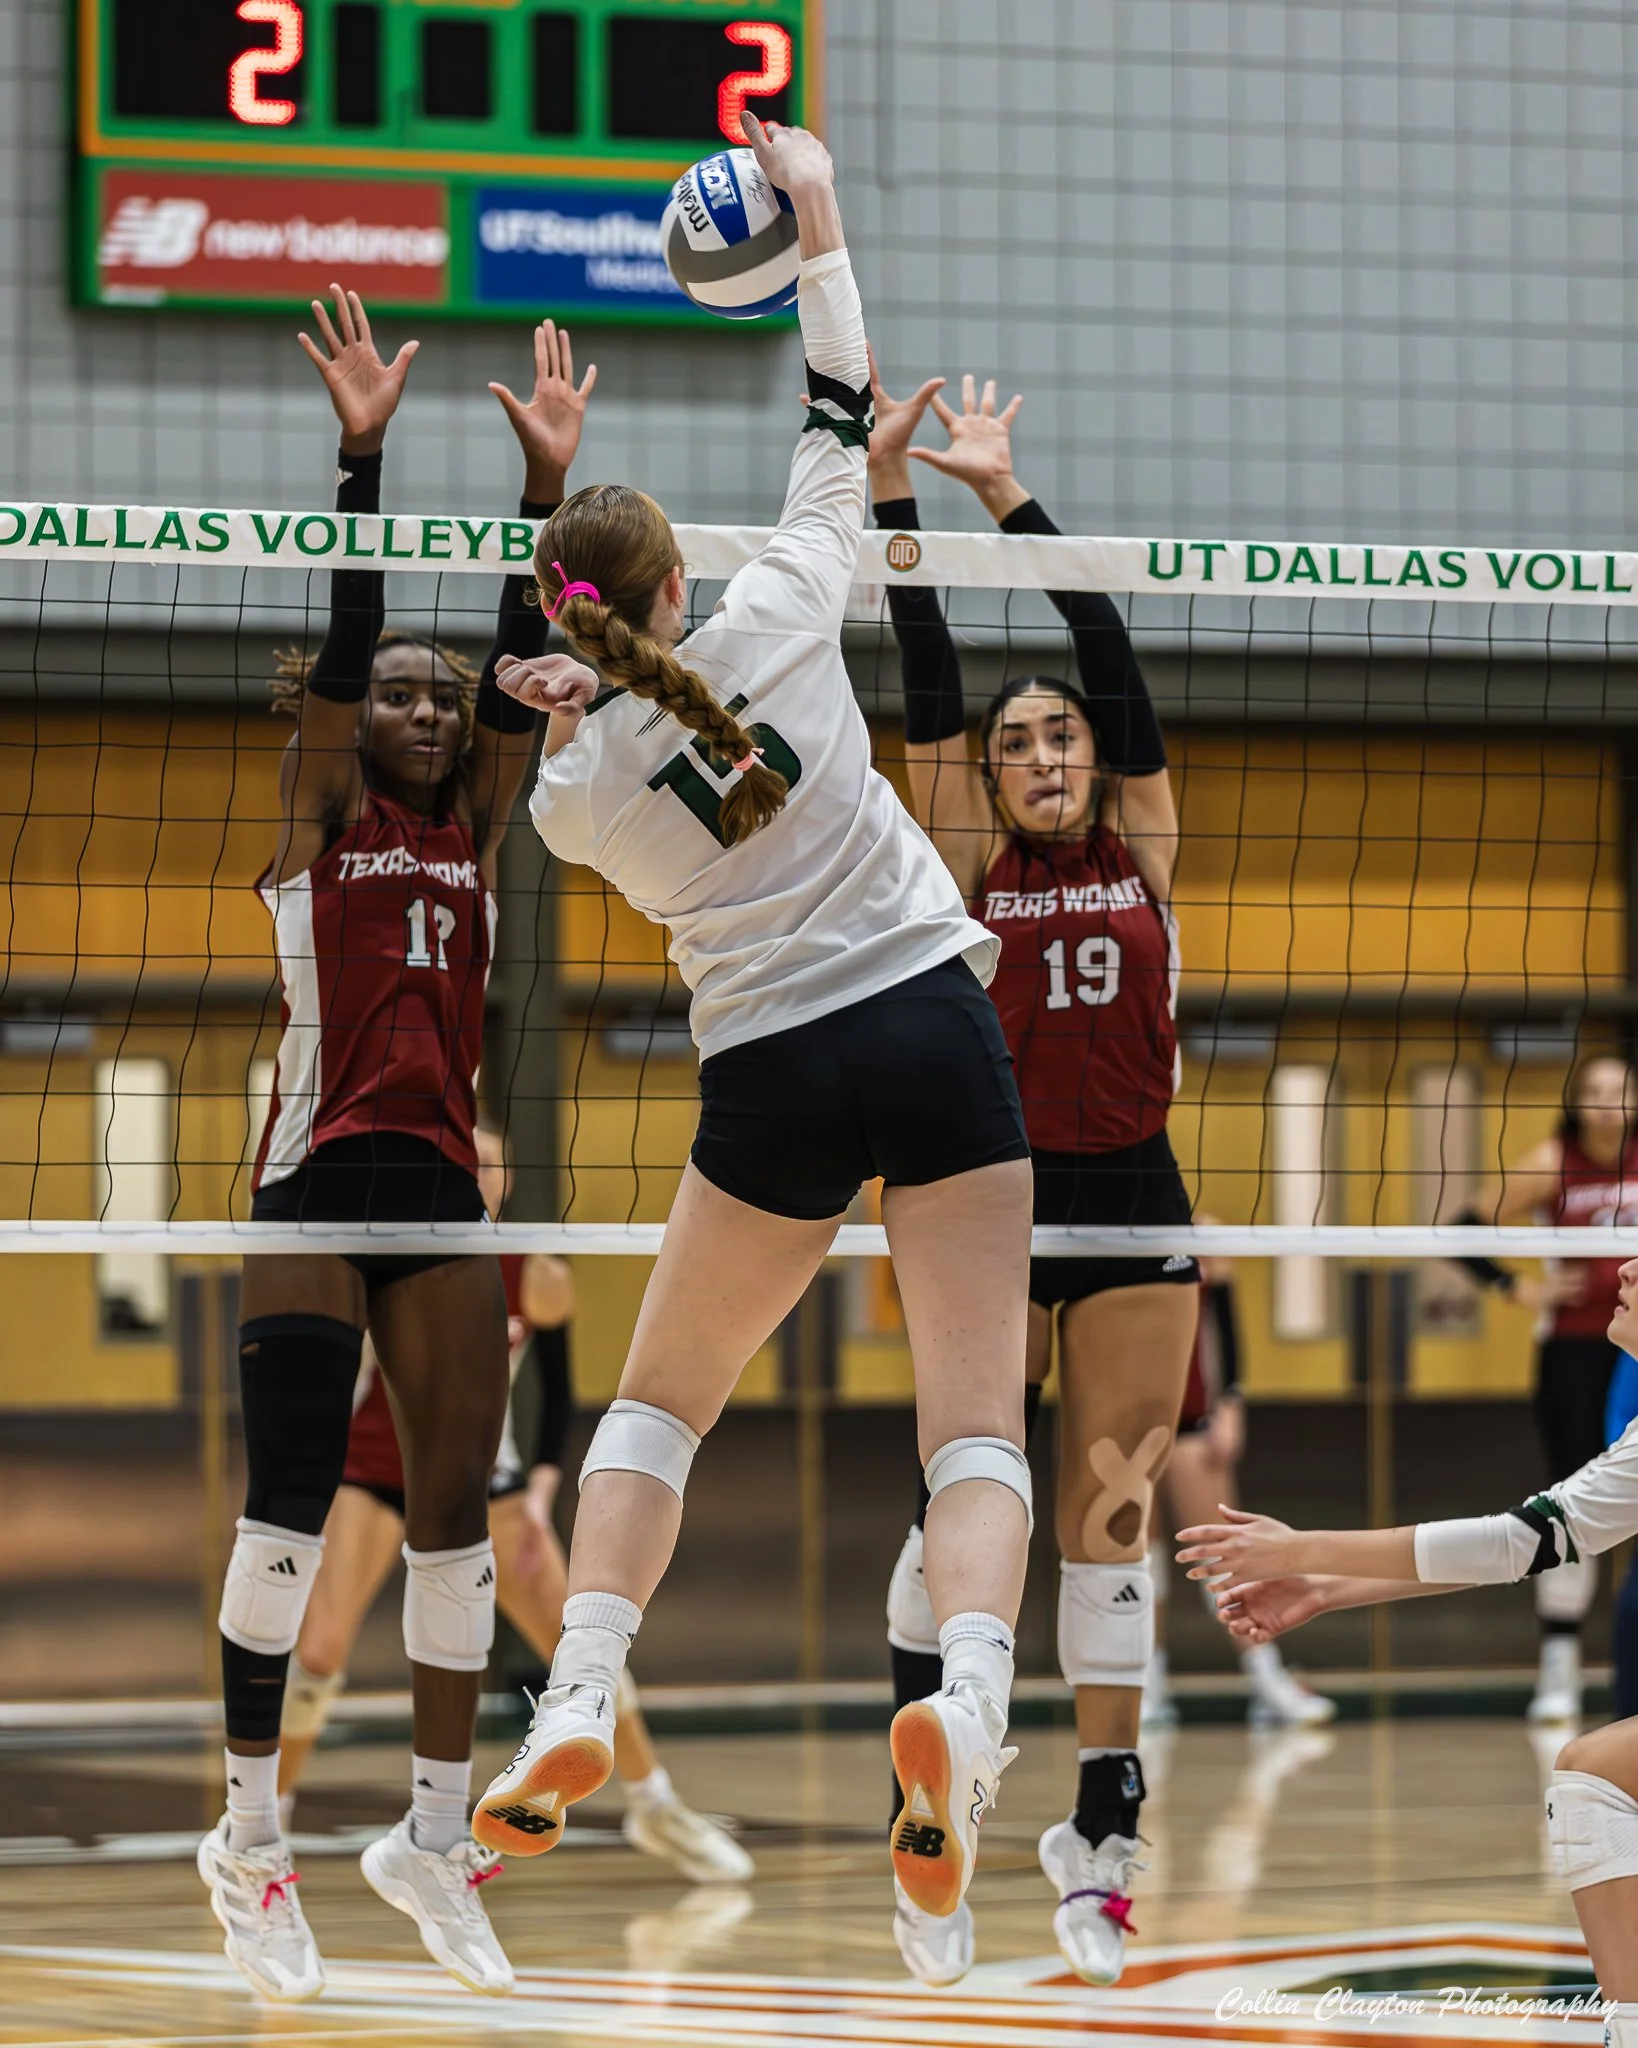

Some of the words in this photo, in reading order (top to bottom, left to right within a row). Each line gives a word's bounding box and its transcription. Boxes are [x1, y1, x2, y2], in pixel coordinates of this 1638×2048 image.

[229, 0, 303, 125] 2
[718, 21, 792, 146] 2
[0, 507, 230, 553] DALLAS
[890, 540, 918, 567] UTD
[1147, 541, 1227, 582] UT
[1244, 544, 1468, 588] DALLAS
[1486, 552, 1633, 593] VOLL
[338, 846, 420, 880] TEXAS
[984, 887, 1059, 923] TEXAS
[1043, 936, 1121, 1010] 19
